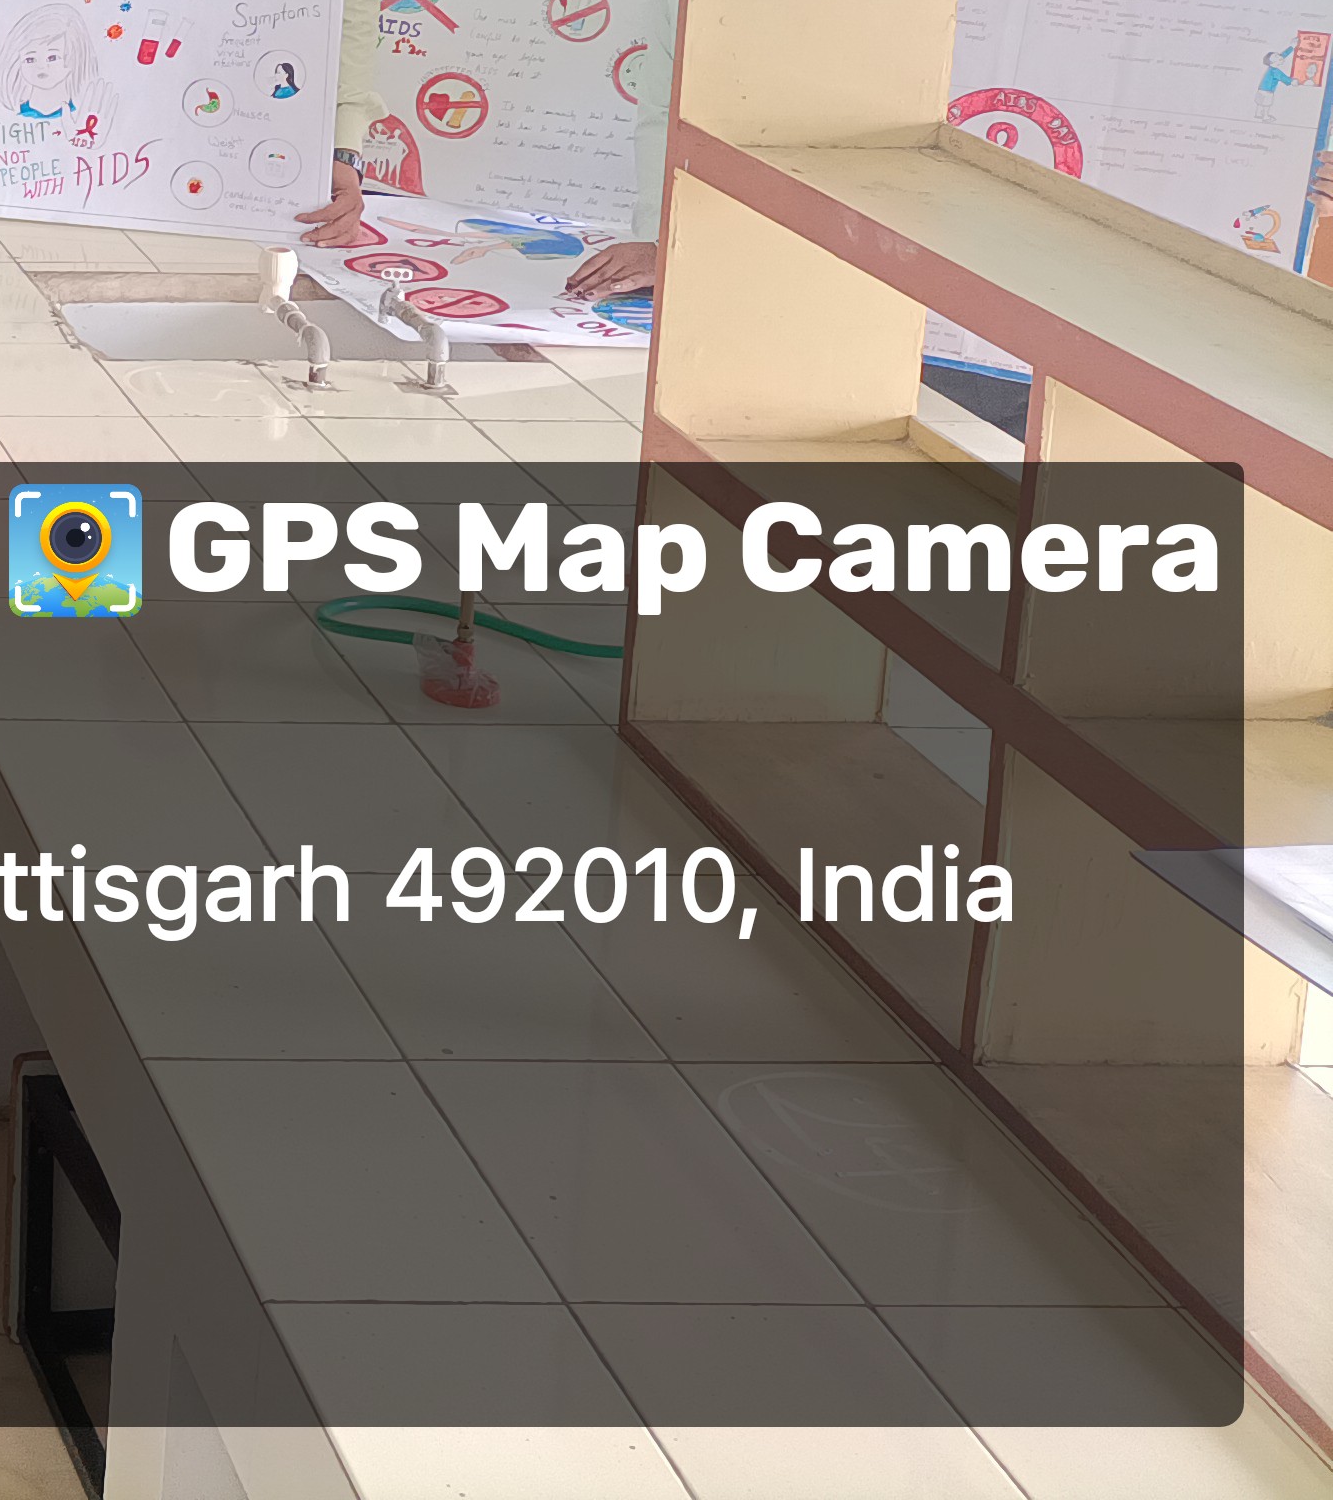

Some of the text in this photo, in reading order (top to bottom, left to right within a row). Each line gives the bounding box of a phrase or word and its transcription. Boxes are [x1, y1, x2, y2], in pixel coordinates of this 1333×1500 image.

[232, 2, 321, 36] Symptoms
[218, 31, 261, 49] frequent
[994, 92, 1077, 146] AIDS DAY
[22, 176, 64, 199] WITH
[72, 138, 163, 209] AIDS
